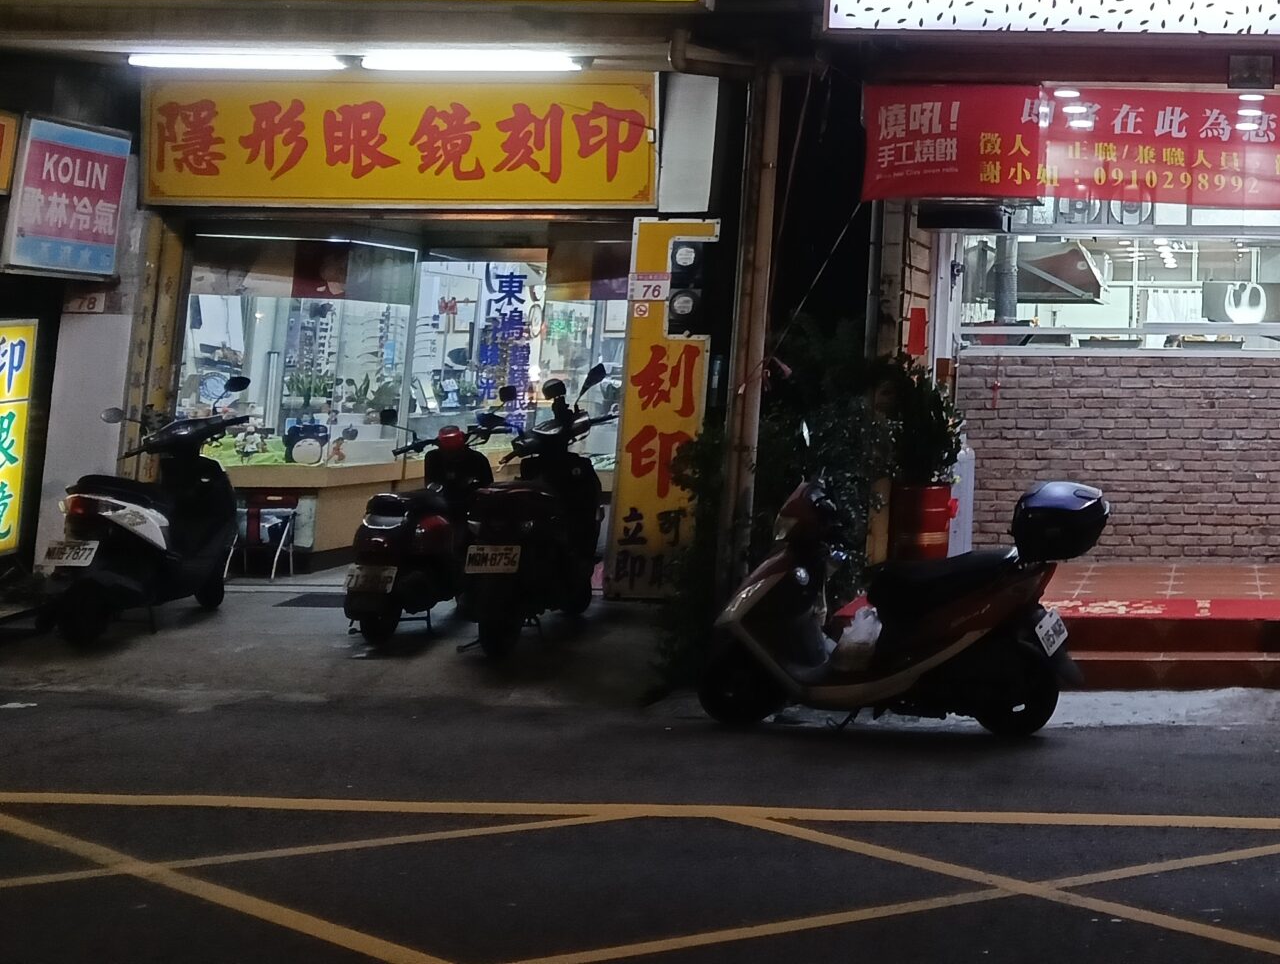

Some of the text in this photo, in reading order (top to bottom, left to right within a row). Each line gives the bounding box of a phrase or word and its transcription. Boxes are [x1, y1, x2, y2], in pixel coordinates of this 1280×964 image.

[155, 97, 648, 185] 隱形眼鏡刻印
[877, 138, 958, 168] 手工燒餅
[42, 152, 109, 191] KOLIN
[78, 296, 97, 311] 78
[642, 284, 662, 299] 76
[625, 344, 701, 499] 刻印
